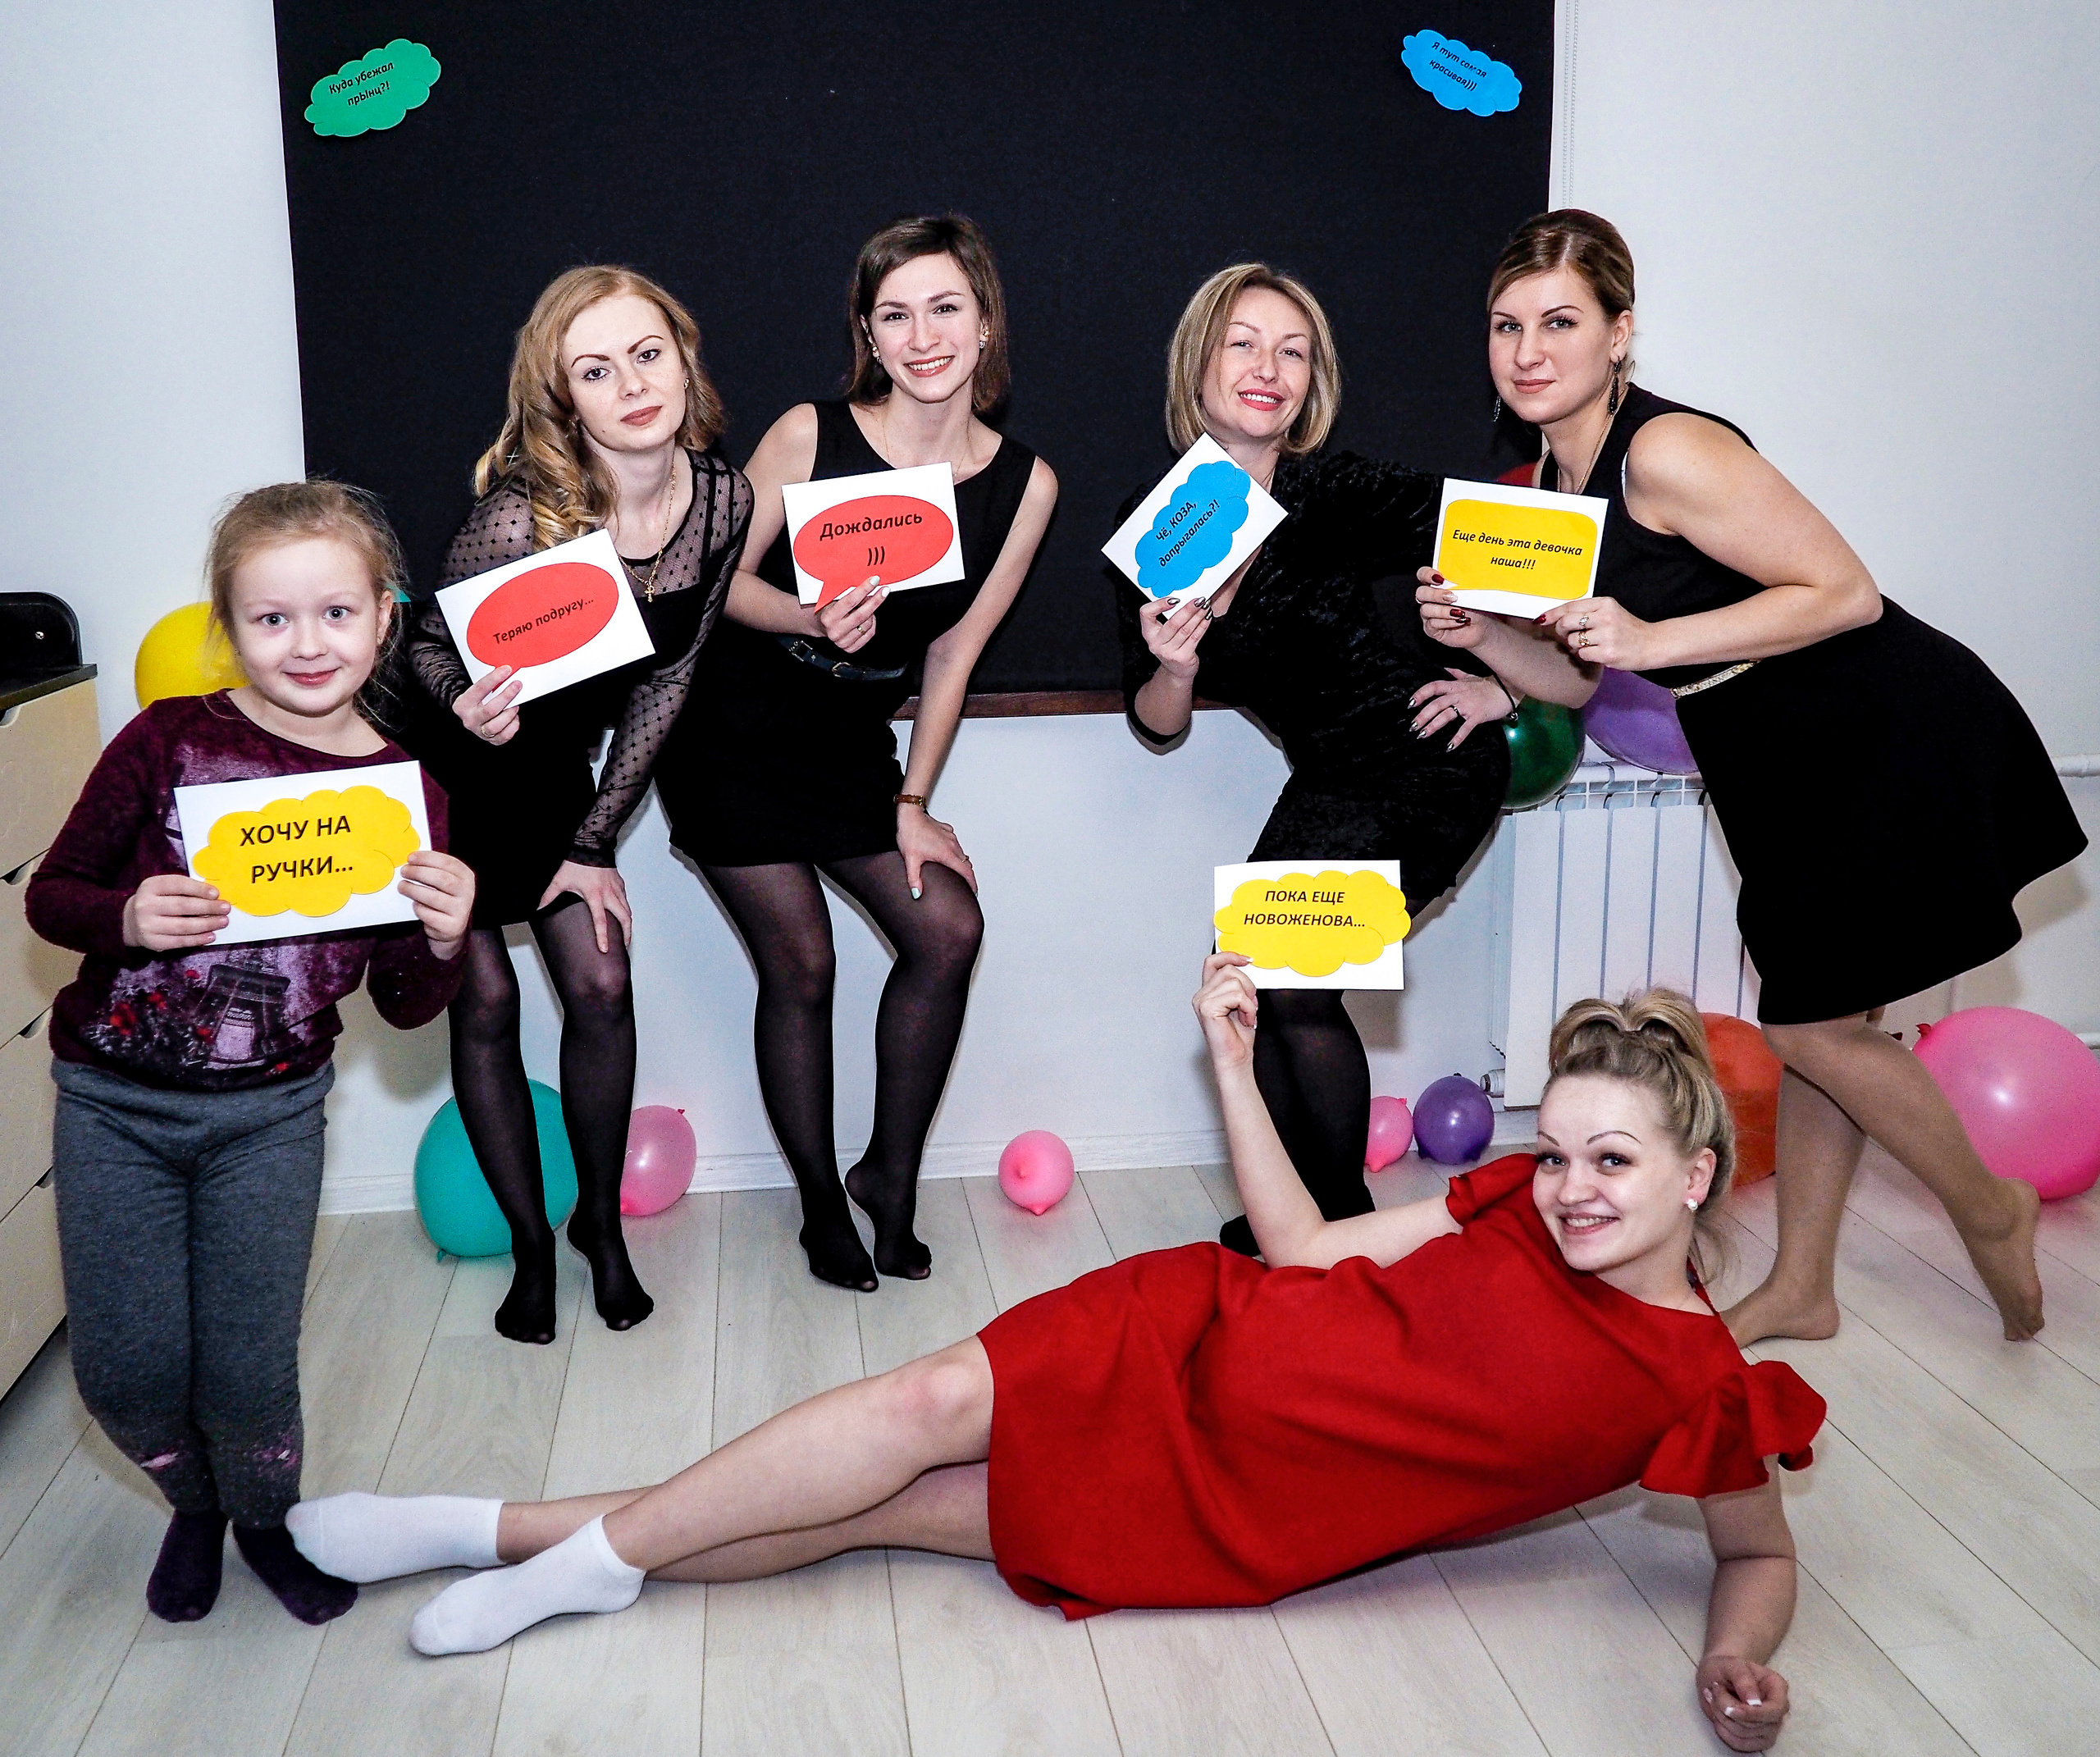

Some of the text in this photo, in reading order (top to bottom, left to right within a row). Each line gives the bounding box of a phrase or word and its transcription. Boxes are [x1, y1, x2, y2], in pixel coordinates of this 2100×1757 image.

[1429, 59, 1477, 91] красивая)))
[1440, 48, 1460, 62] тут
[1460, 60, 1487, 78] самая
[329, 62, 395, 94] Куда убежал
[819, 513, 923, 541] Дождались
[1156, 501, 1197, 541] Чё, КОЗА,
[1158, 499, 1221, 568] допрыгалась?!
[867, 545, 885, 566] )))
[1453, 529, 1583, 556] Еще день эта девочка
[1491, 556, 1536, 570] наша!!!
[493, 598, 594, 645] Теряю подругу...
[240, 815, 352, 847] ХОЧУ НА
[250, 856, 354, 884] РУЧКИ...
[1265, 890, 1345, 905] ПОКА ЕЩЕ
[1244, 913, 1366, 928] НОВОЖЕНОВА...
